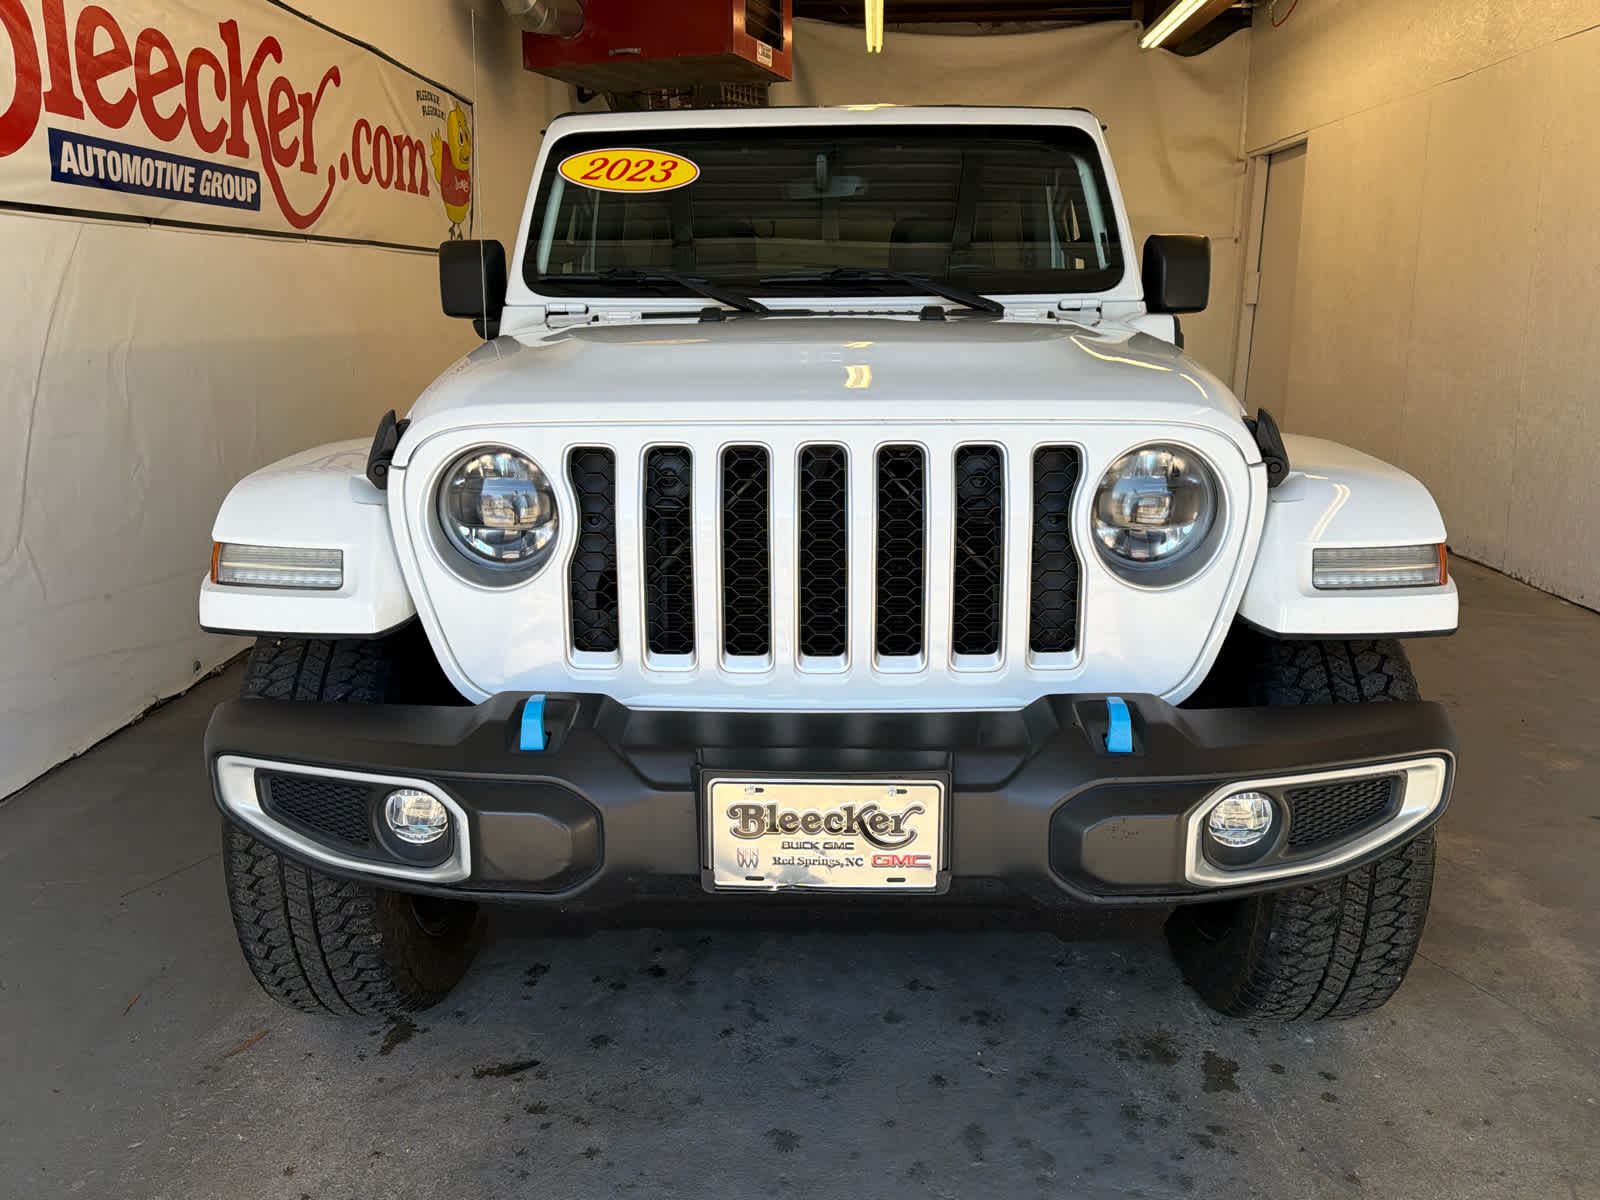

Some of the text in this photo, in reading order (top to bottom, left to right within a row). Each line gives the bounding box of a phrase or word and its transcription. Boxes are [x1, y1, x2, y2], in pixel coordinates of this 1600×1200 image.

[60, 141, 257, 203] AUTOMOTIVE GROUP
[581, 157, 679, 183] 2023
[726, 801, 925, 850] Bleecker
[781, 841, 855, 850] BUICK GMC
[772, 856, 796, 866] Red
[871, 854, 932, 868] GMC
